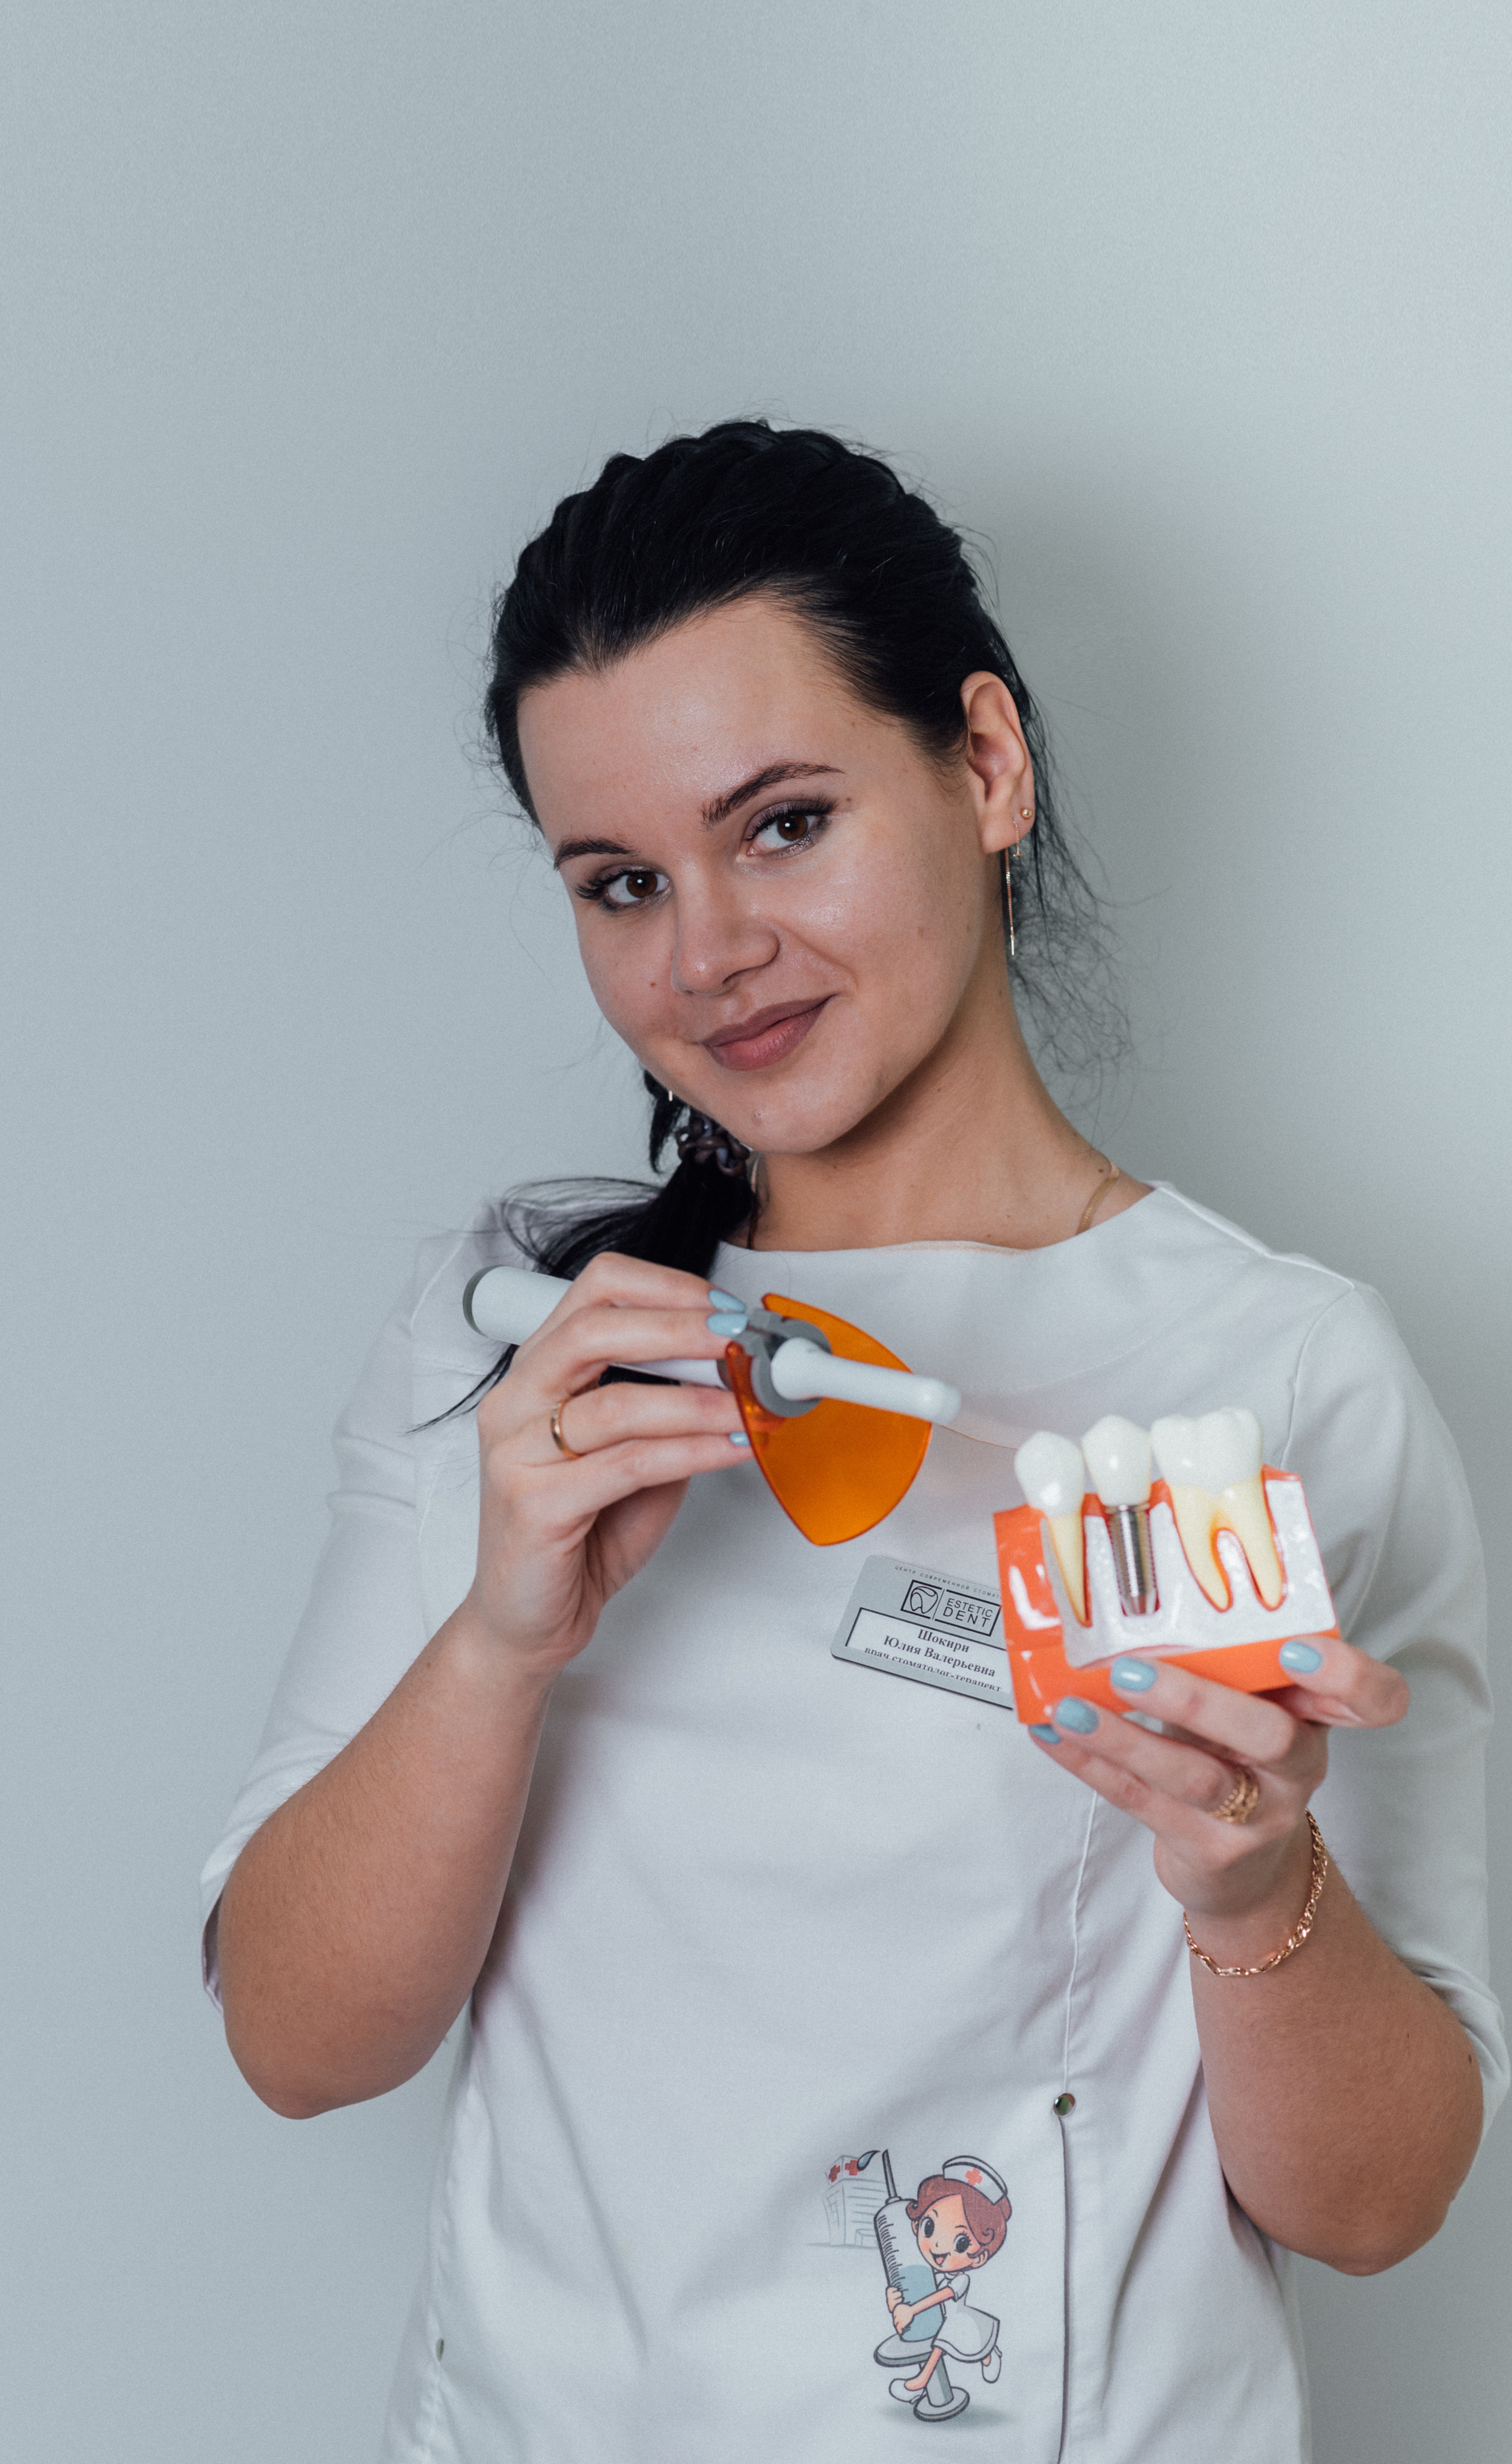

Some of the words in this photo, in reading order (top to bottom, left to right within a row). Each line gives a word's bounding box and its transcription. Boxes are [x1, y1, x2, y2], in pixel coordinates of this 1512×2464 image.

[894, 1565, 916, 1574] ЦЕНТР
[920, 1572, 970, 1590] СОВРЕМЕННОЙ
[973, 1588, 1001, 1600] СТОМАТ
[943, 1606, 990, 1627] DENT
[947, 1598, 993, 1618] ESTETIC
[917, 1629, 970, 1653] Шокири
[884, 1635, 921, 1655] Юлия
[924, 1646, 996, 1677] Валерьевна
